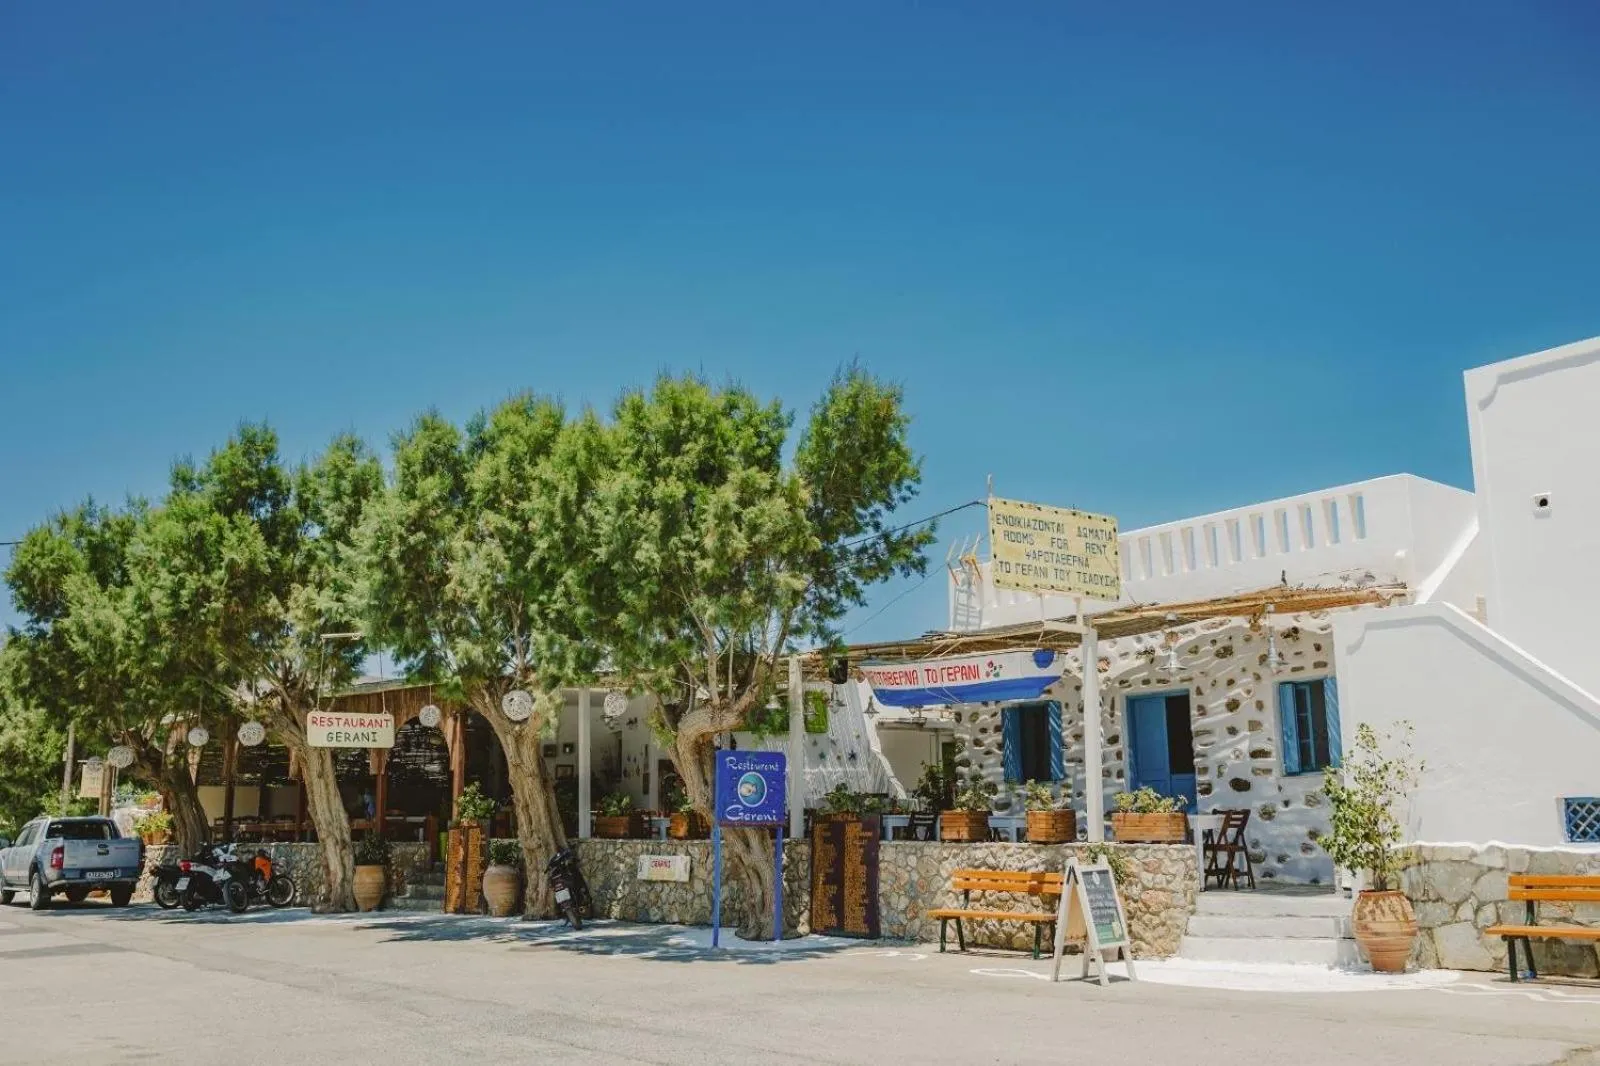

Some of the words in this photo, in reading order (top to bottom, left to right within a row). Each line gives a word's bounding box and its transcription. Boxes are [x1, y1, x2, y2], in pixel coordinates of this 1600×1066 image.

[1003, 529, 1035, 546] ROOMS
[1050, 536, 1069, 551] FOR
[1085, 542, 1107, 555] RENT
[998, 560, 1011, 574] ΤΟ
[1014, 564, 1049, 580] ΓΕΡΑΝΙ
[923, 668, 938, 684] ΤΟ
[941, 663, 981, 683] ΓΕΡΑΝΙ
[311, 715, 392, 729] RESTAURANT
[326, 731, 378, 743] GERANI
[725, 804, 778, 821] Gerani
